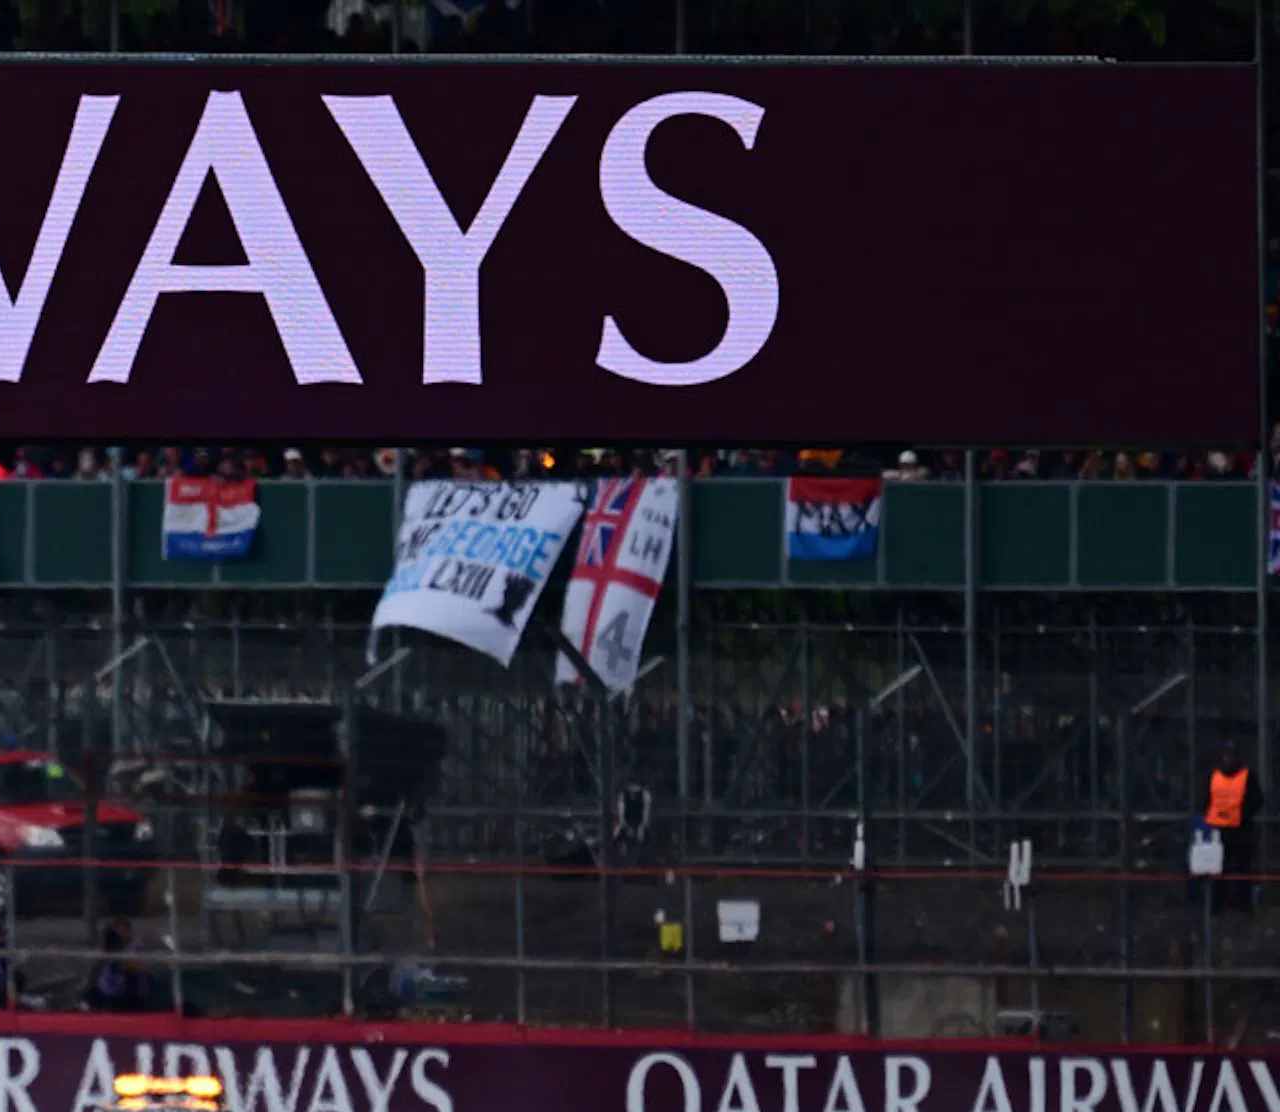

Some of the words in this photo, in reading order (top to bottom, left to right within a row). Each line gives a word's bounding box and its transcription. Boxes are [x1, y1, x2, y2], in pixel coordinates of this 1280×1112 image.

[795, 499, 873, 538] MAX
[428, 520, 561, 580] GEORGE
[629, 531, 663, 564] LH
[596, 610, 633, 673] 4
